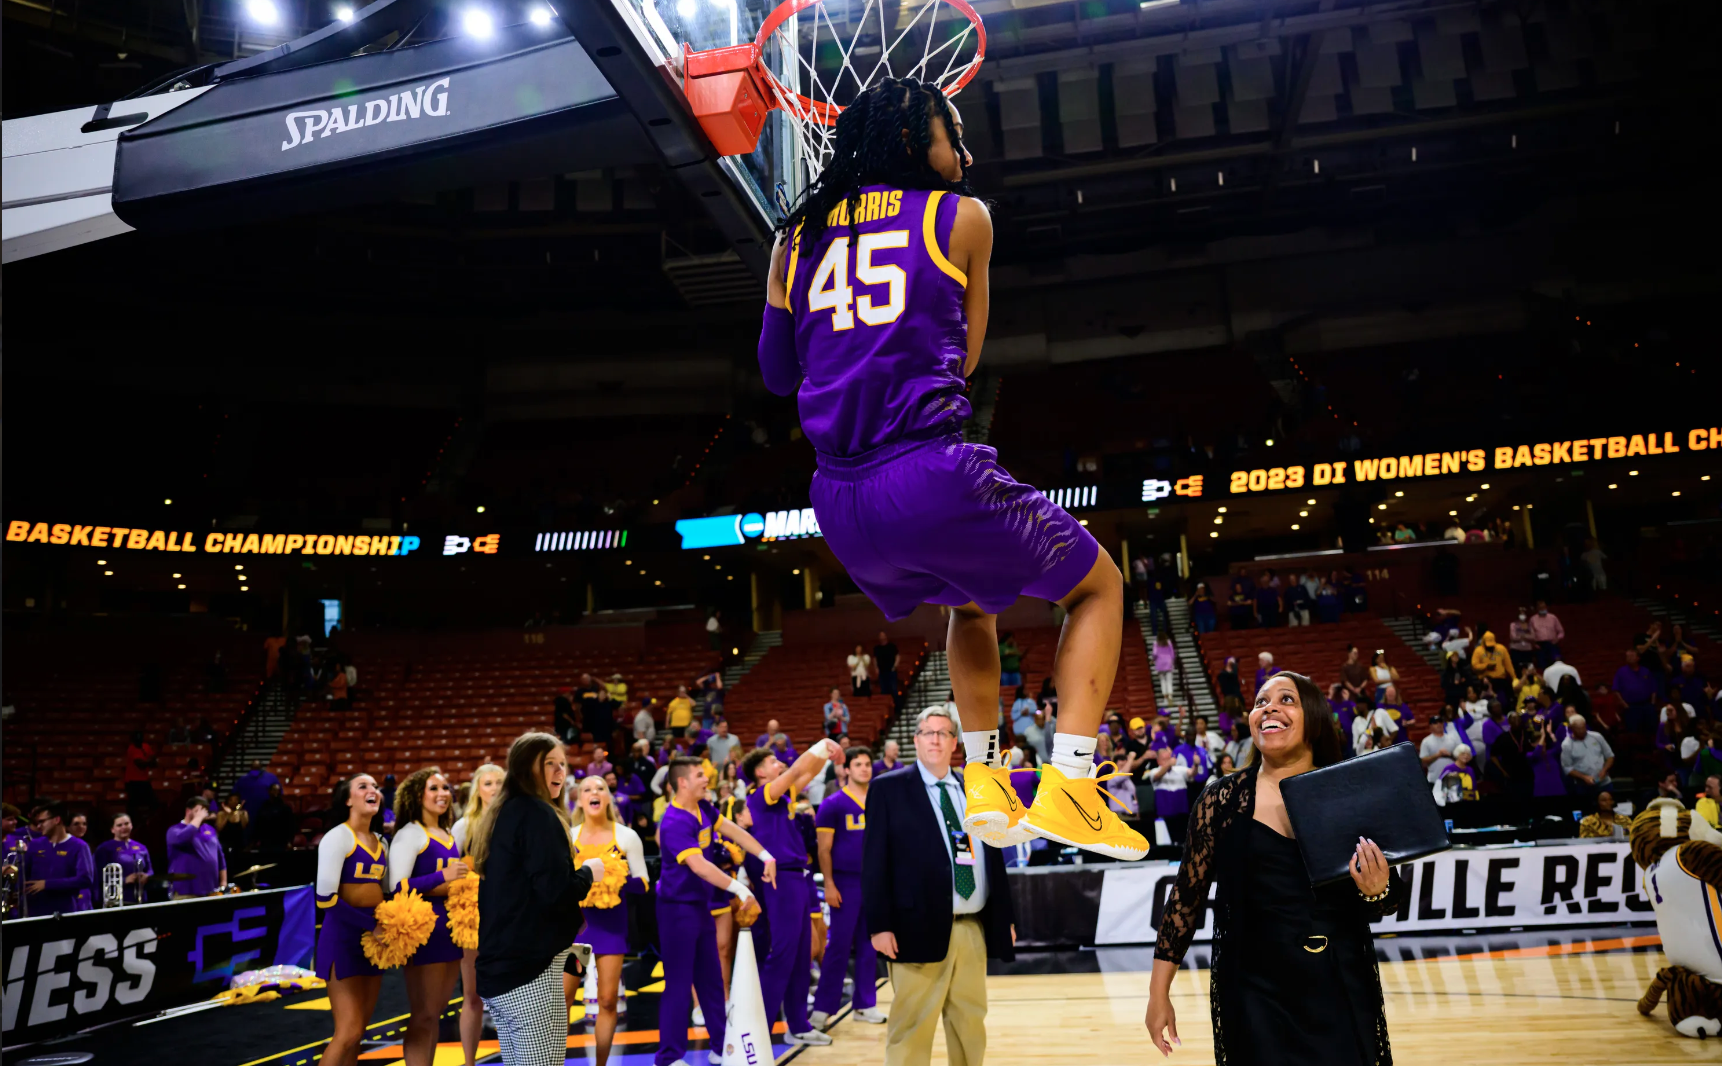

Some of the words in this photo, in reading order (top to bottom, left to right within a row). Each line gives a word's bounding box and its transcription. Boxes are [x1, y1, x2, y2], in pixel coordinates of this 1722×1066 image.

[281, 77, 450, 151] SPALDING
[808, 230, 909, 331] 45
[1230, 465, 1305, 494] 2023
[1313, 461, 1347, 486] DI
[1354, 449, 1486, 482] WOMEN'S
[1494, 431, 1680, 469] BASKETBALL
[1688, 427, 1722, 450] CH
[6, 520, 196, 552] BASKETBALL
[204, 532, 420, 556] CHAMPIONSHIP
[763, 508, 822, 538] MAR
[1366, 568, 1389, 580] 114
[1372, 857, 1520, 923] ILLE
[741, 1032, 757, 1065] LSU
